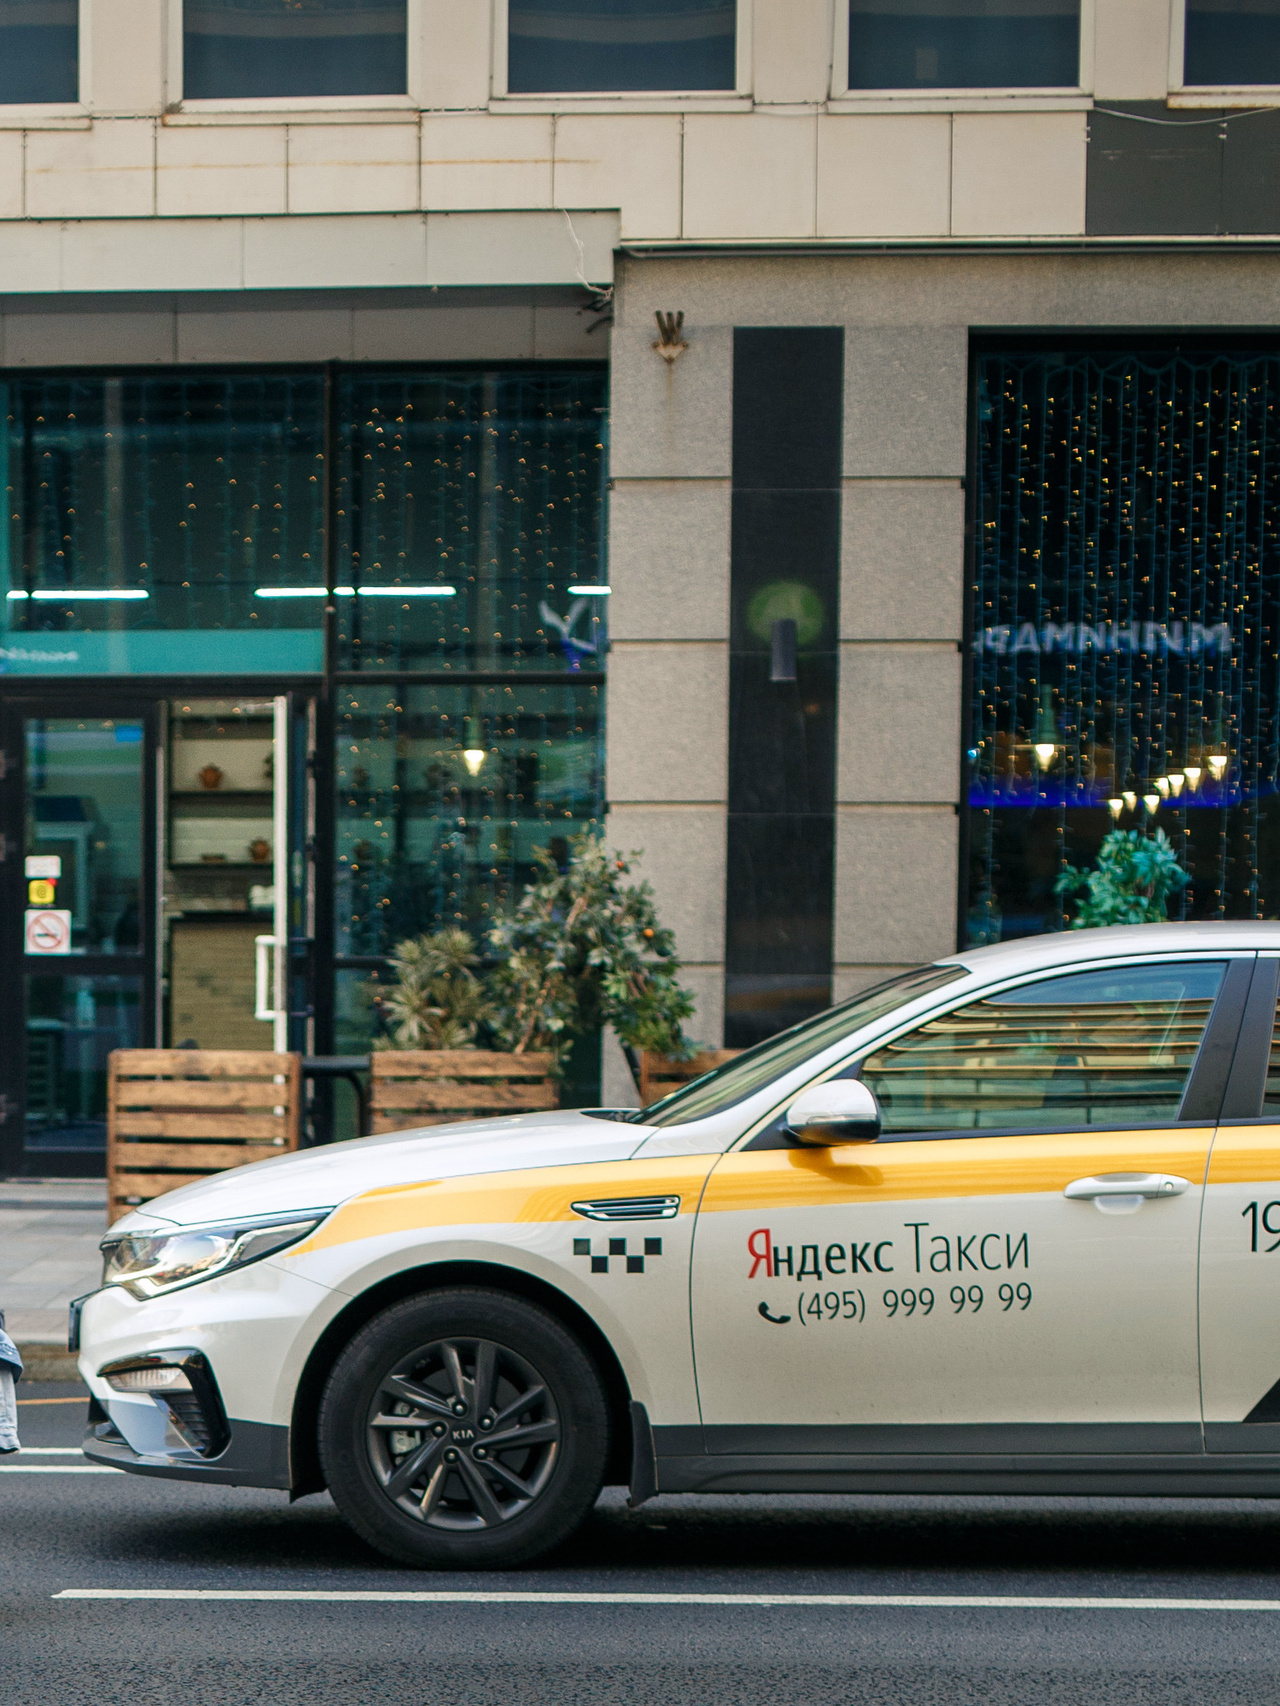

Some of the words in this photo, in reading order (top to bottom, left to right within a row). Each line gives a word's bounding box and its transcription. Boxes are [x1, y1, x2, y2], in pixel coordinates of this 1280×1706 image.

[1242, 1200, 1280, 1253] 19
[748, 1228, 894, 1281] Яндекс
[904, 1222, 1031, 1273] Такси
[797, 1289, 867, 1326] (495)
[883, 1286, 935, 1318] 999
[949, 1284, 984, 1315] 99
[998, 1282, 1032, 1312] 99
[452, 1429, 474, 1440] KIA
